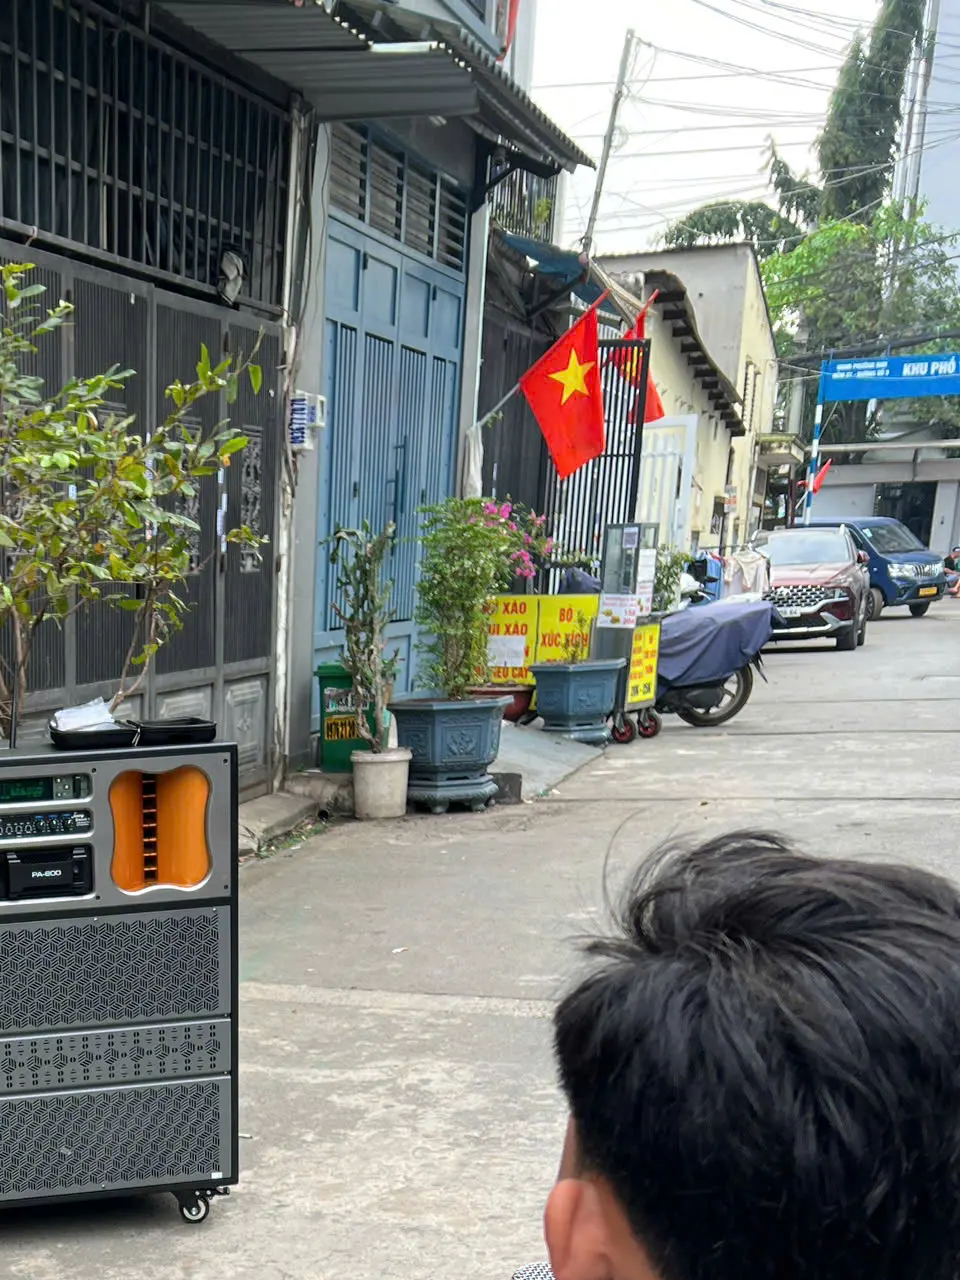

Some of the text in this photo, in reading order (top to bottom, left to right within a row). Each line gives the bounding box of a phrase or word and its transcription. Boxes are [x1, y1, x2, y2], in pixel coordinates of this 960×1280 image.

[902, 362, 928, 377] KHU
[930, 356, 956, 375] PHỐ
[502, 600, 527, 615] XÀO
[504, 621, 528, 636] XÀO
